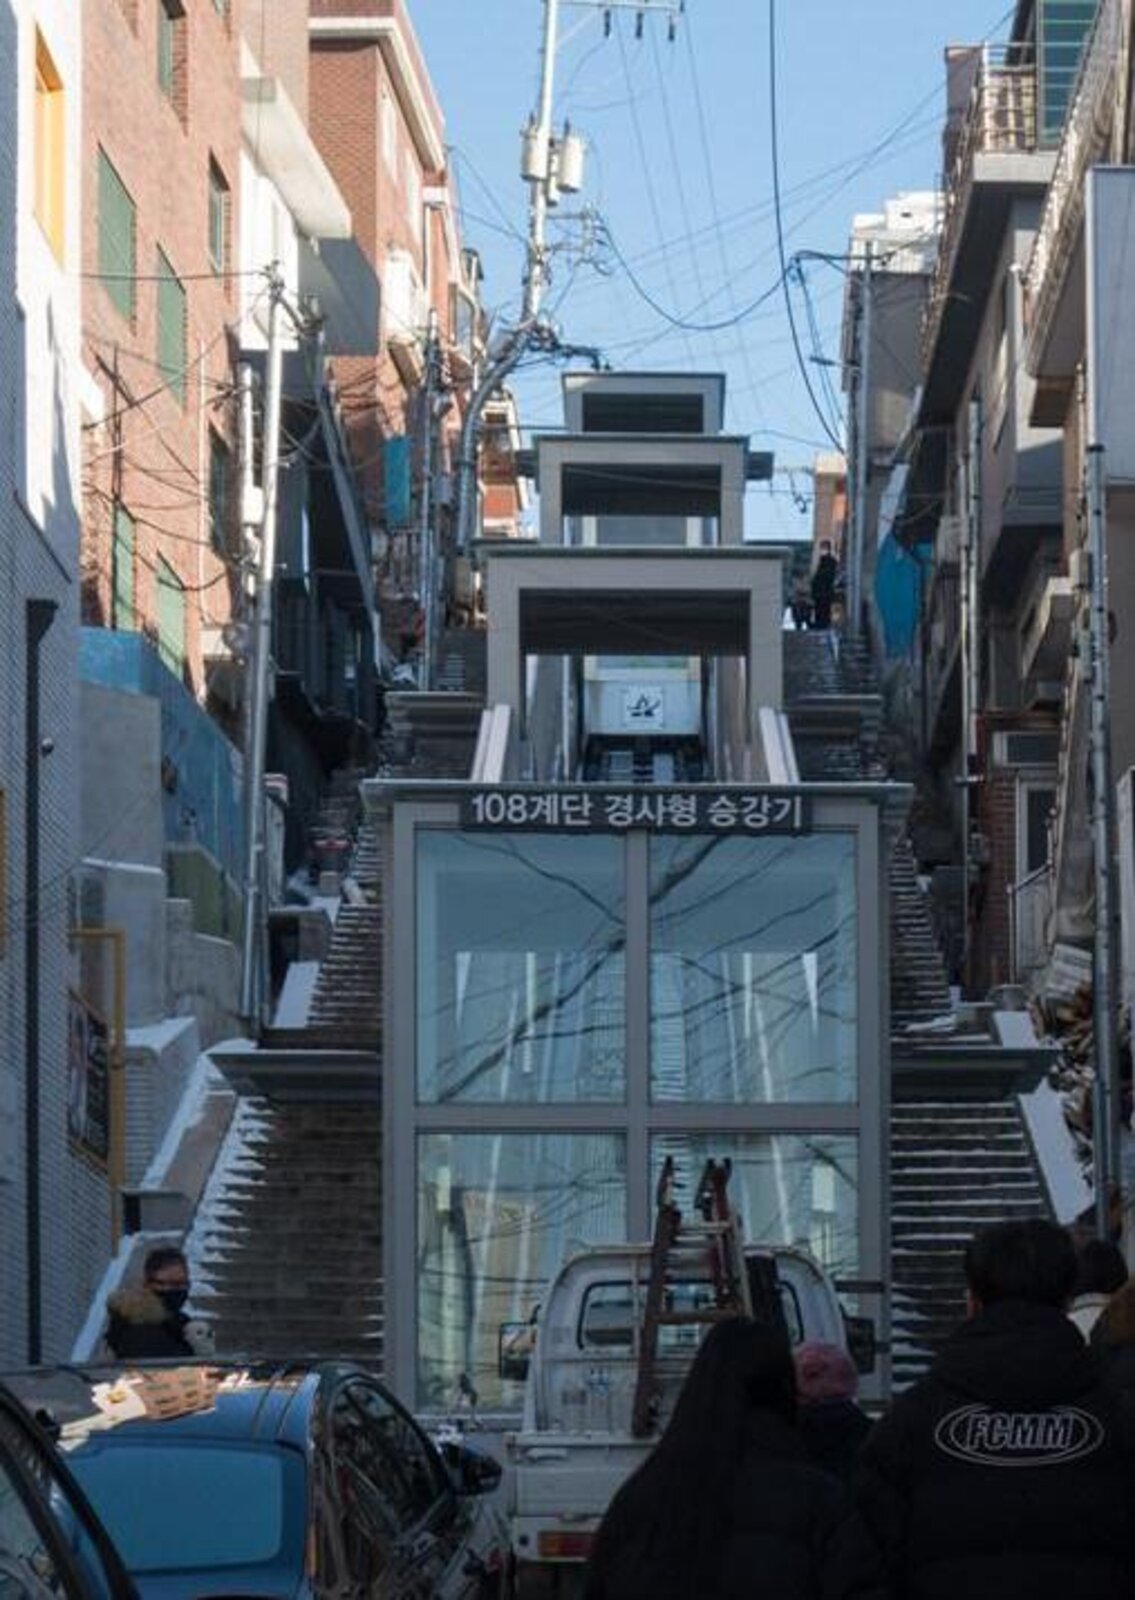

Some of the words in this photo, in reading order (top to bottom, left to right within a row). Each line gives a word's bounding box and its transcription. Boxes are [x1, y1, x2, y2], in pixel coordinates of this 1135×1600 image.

[472, 793, 592, 826] 108계단
[604, 794, 697, 828] 경사형
[707, 795, 802, 829] 승강기
[967, 1412, 1073, 1450] FCMM
